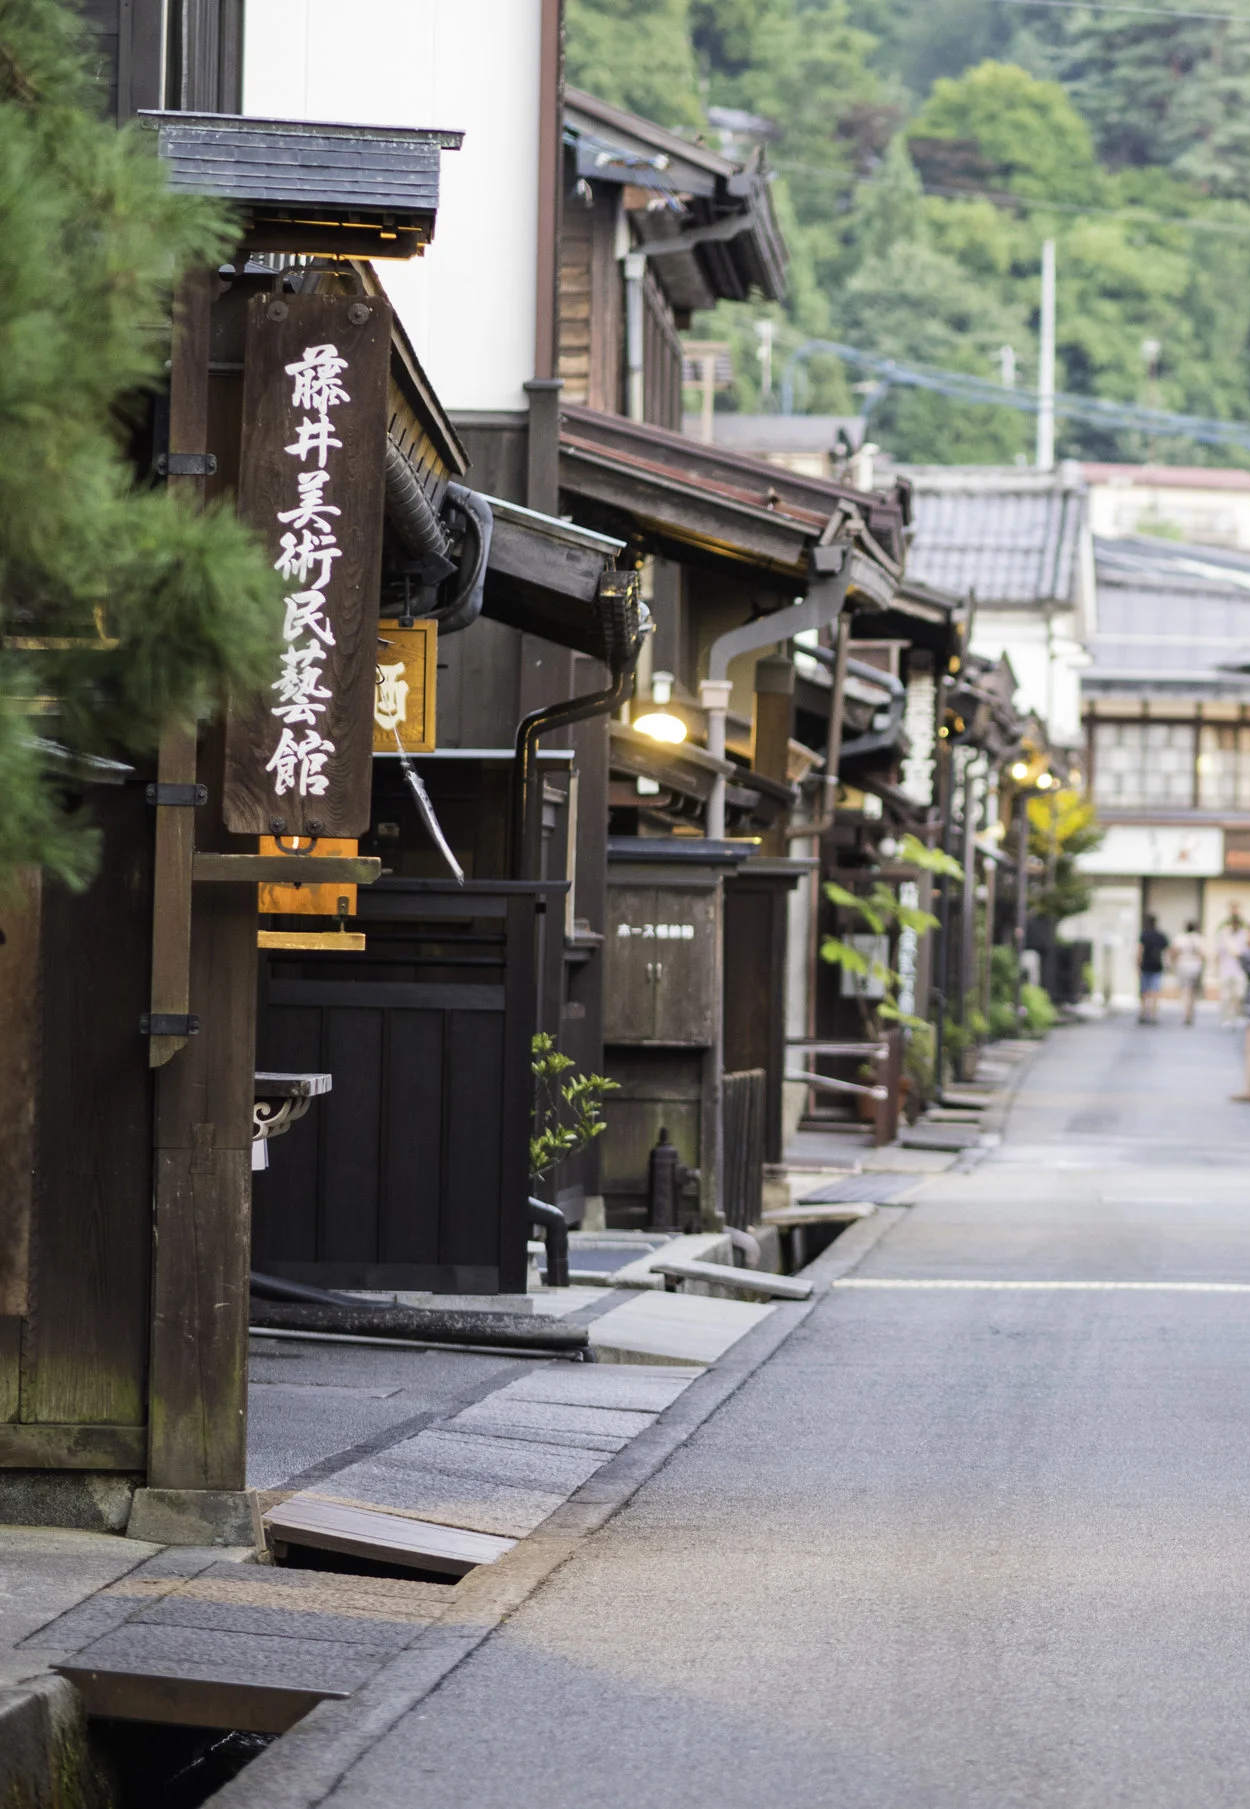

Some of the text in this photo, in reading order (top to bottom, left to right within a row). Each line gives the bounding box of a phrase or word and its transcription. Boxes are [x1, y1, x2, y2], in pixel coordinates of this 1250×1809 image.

[265, 343, 351, 797] 藤井美術民藝館
